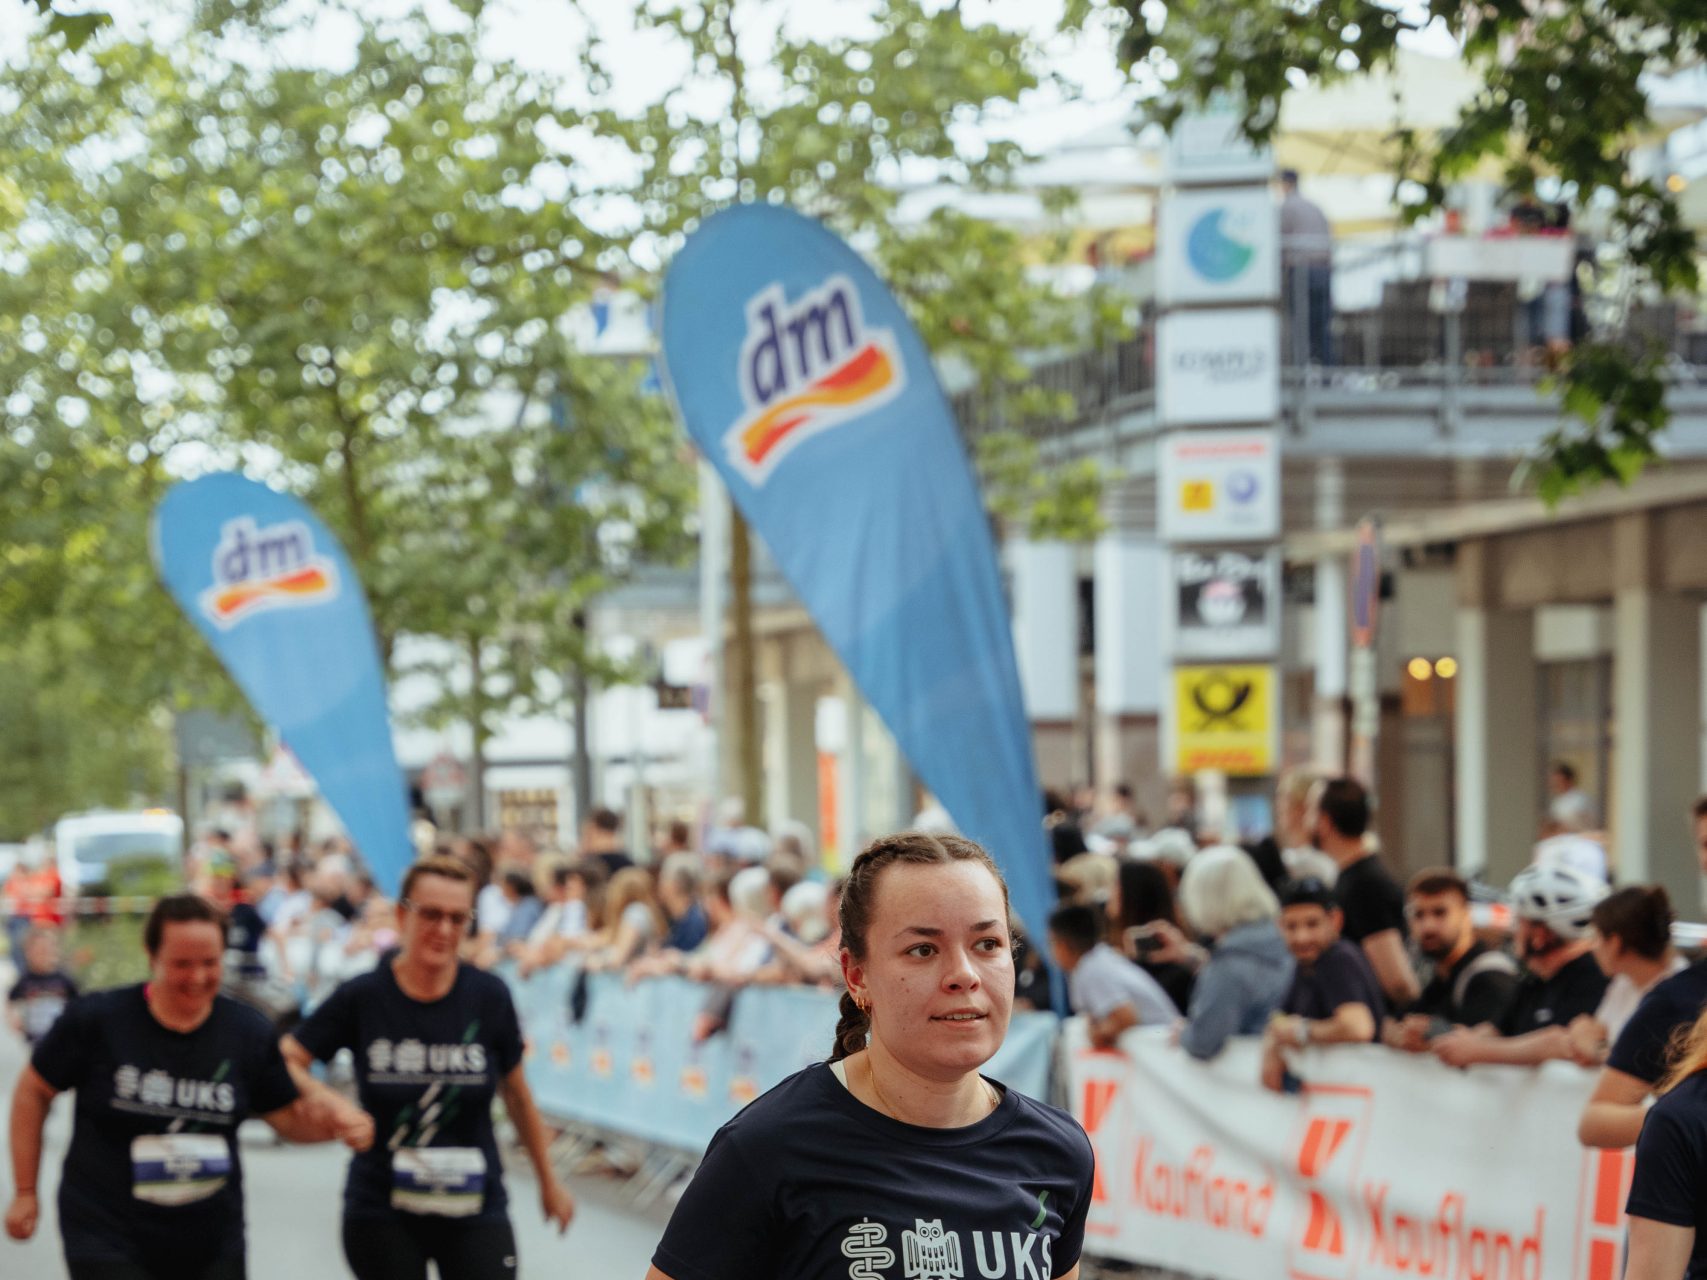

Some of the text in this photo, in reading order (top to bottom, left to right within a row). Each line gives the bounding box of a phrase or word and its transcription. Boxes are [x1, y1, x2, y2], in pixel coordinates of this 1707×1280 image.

[753, 289, 854, 403] dm
[220, 526, 305, 583] dm
[428, 1042, 487, 1073] UKS
[176, 1078, 235, 1113] UKS
